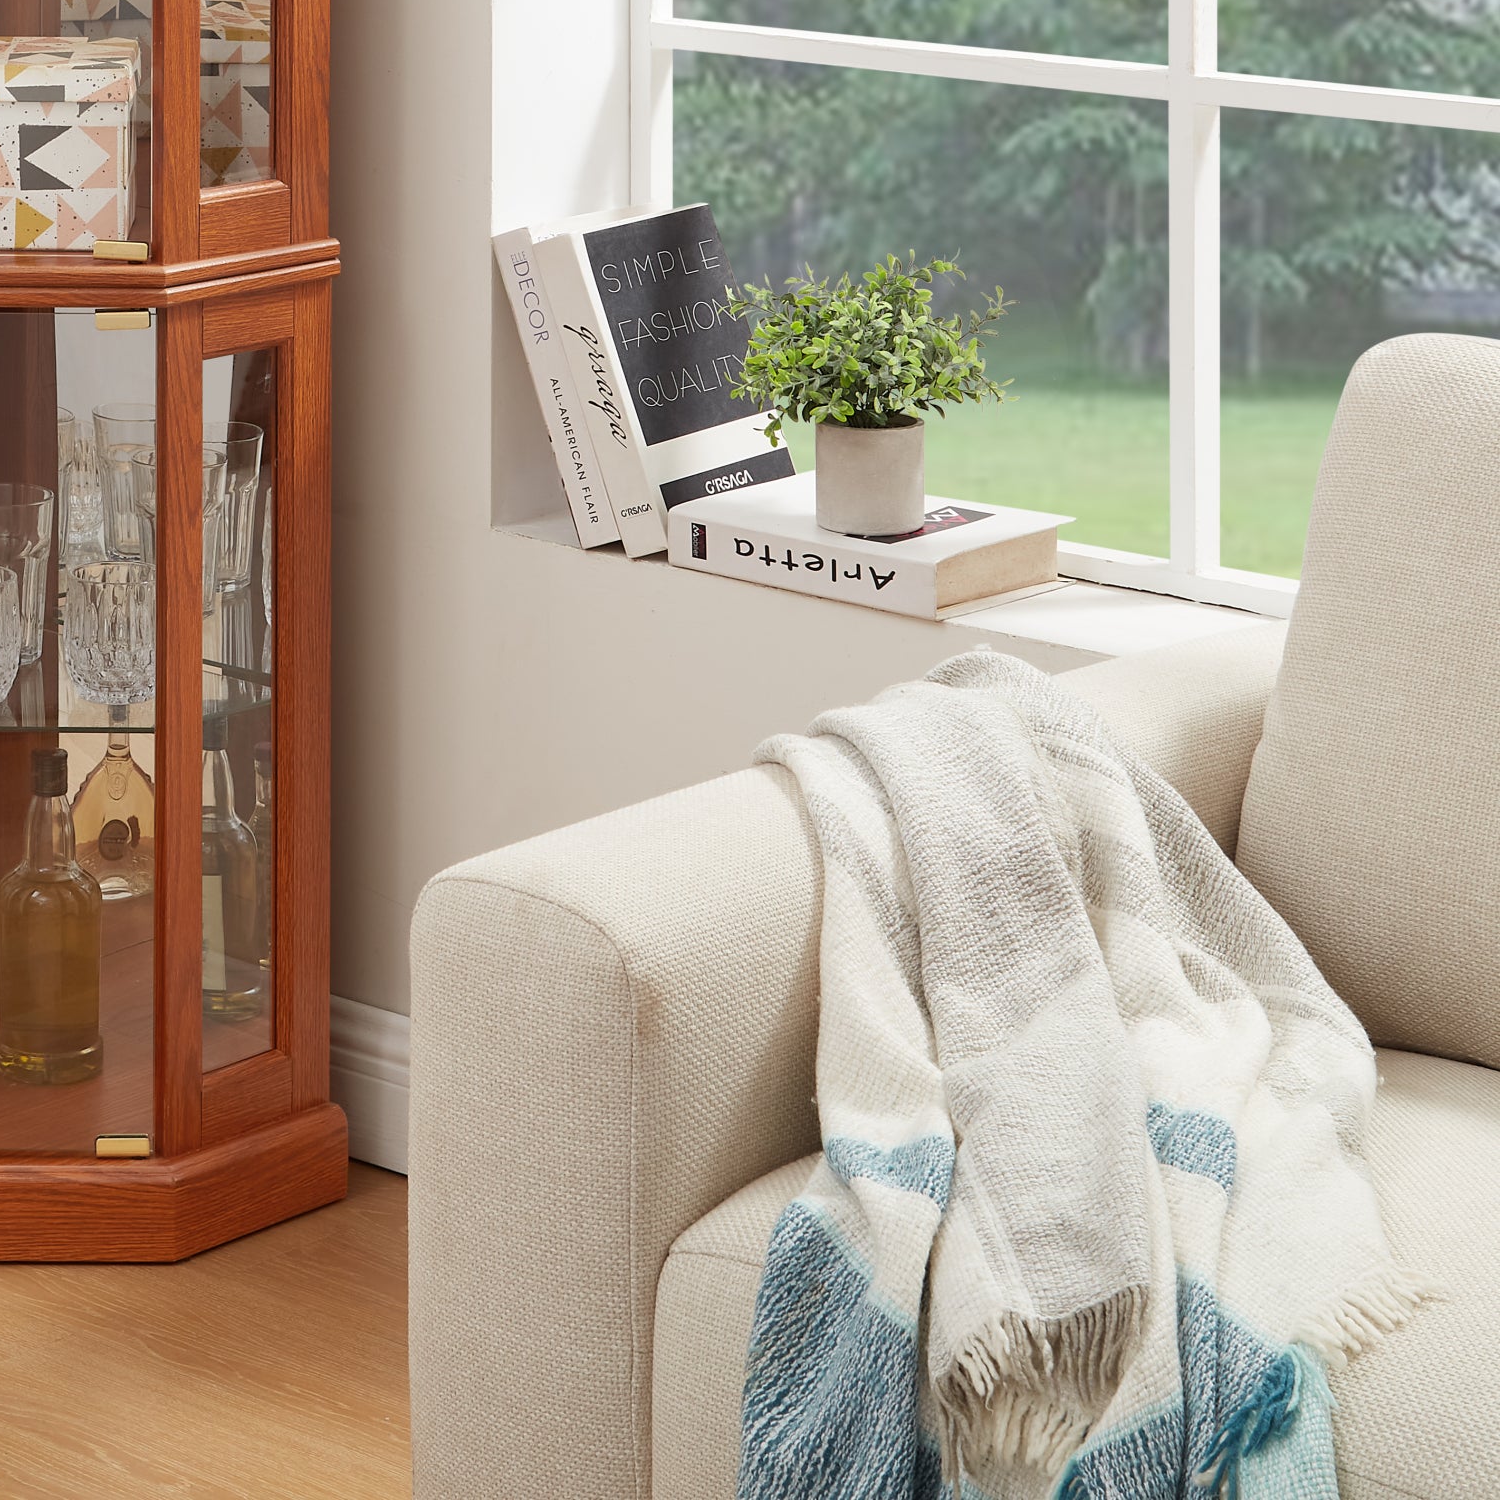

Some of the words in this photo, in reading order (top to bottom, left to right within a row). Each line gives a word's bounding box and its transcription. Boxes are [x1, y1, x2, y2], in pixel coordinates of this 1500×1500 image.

[510, 250, 527, 264] ELLE
[601, 239, 720, 293] SIMPLE
[513, 260, 550, 345] DECOR
[617, 286, 737, 351] FASHION
[550, 378, 587, 481] ALL-AMERICAN
[581, 486, 599, 524] FLAIR
[733, 538, 896, 591] Arletta
